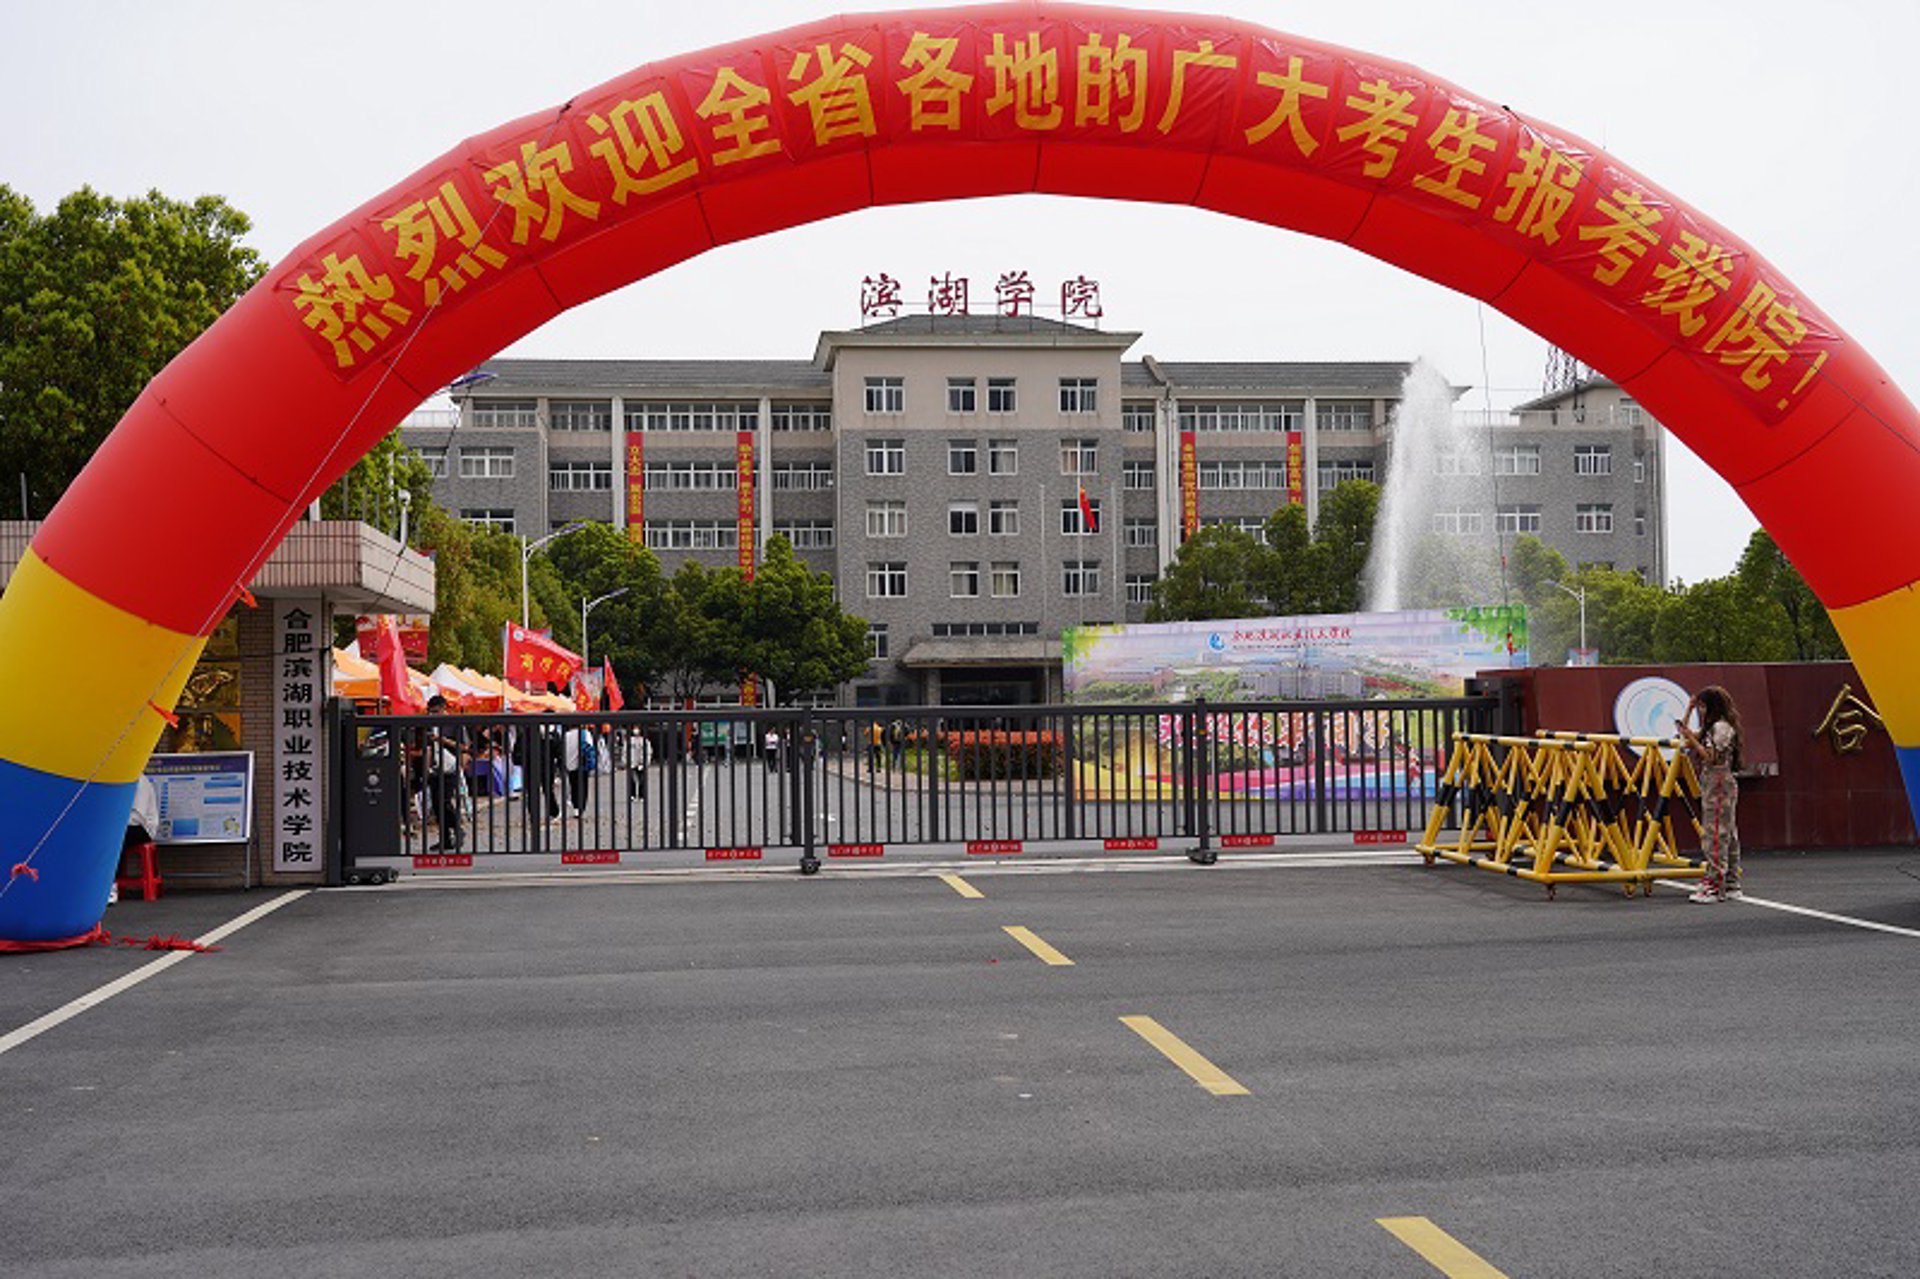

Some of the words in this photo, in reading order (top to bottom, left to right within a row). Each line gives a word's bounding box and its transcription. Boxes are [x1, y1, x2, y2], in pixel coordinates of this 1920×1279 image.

[861, 271, 1103, 317] 滨湖学院
[282, 608, 313, 863] 合肥滨湖职业技术学院
